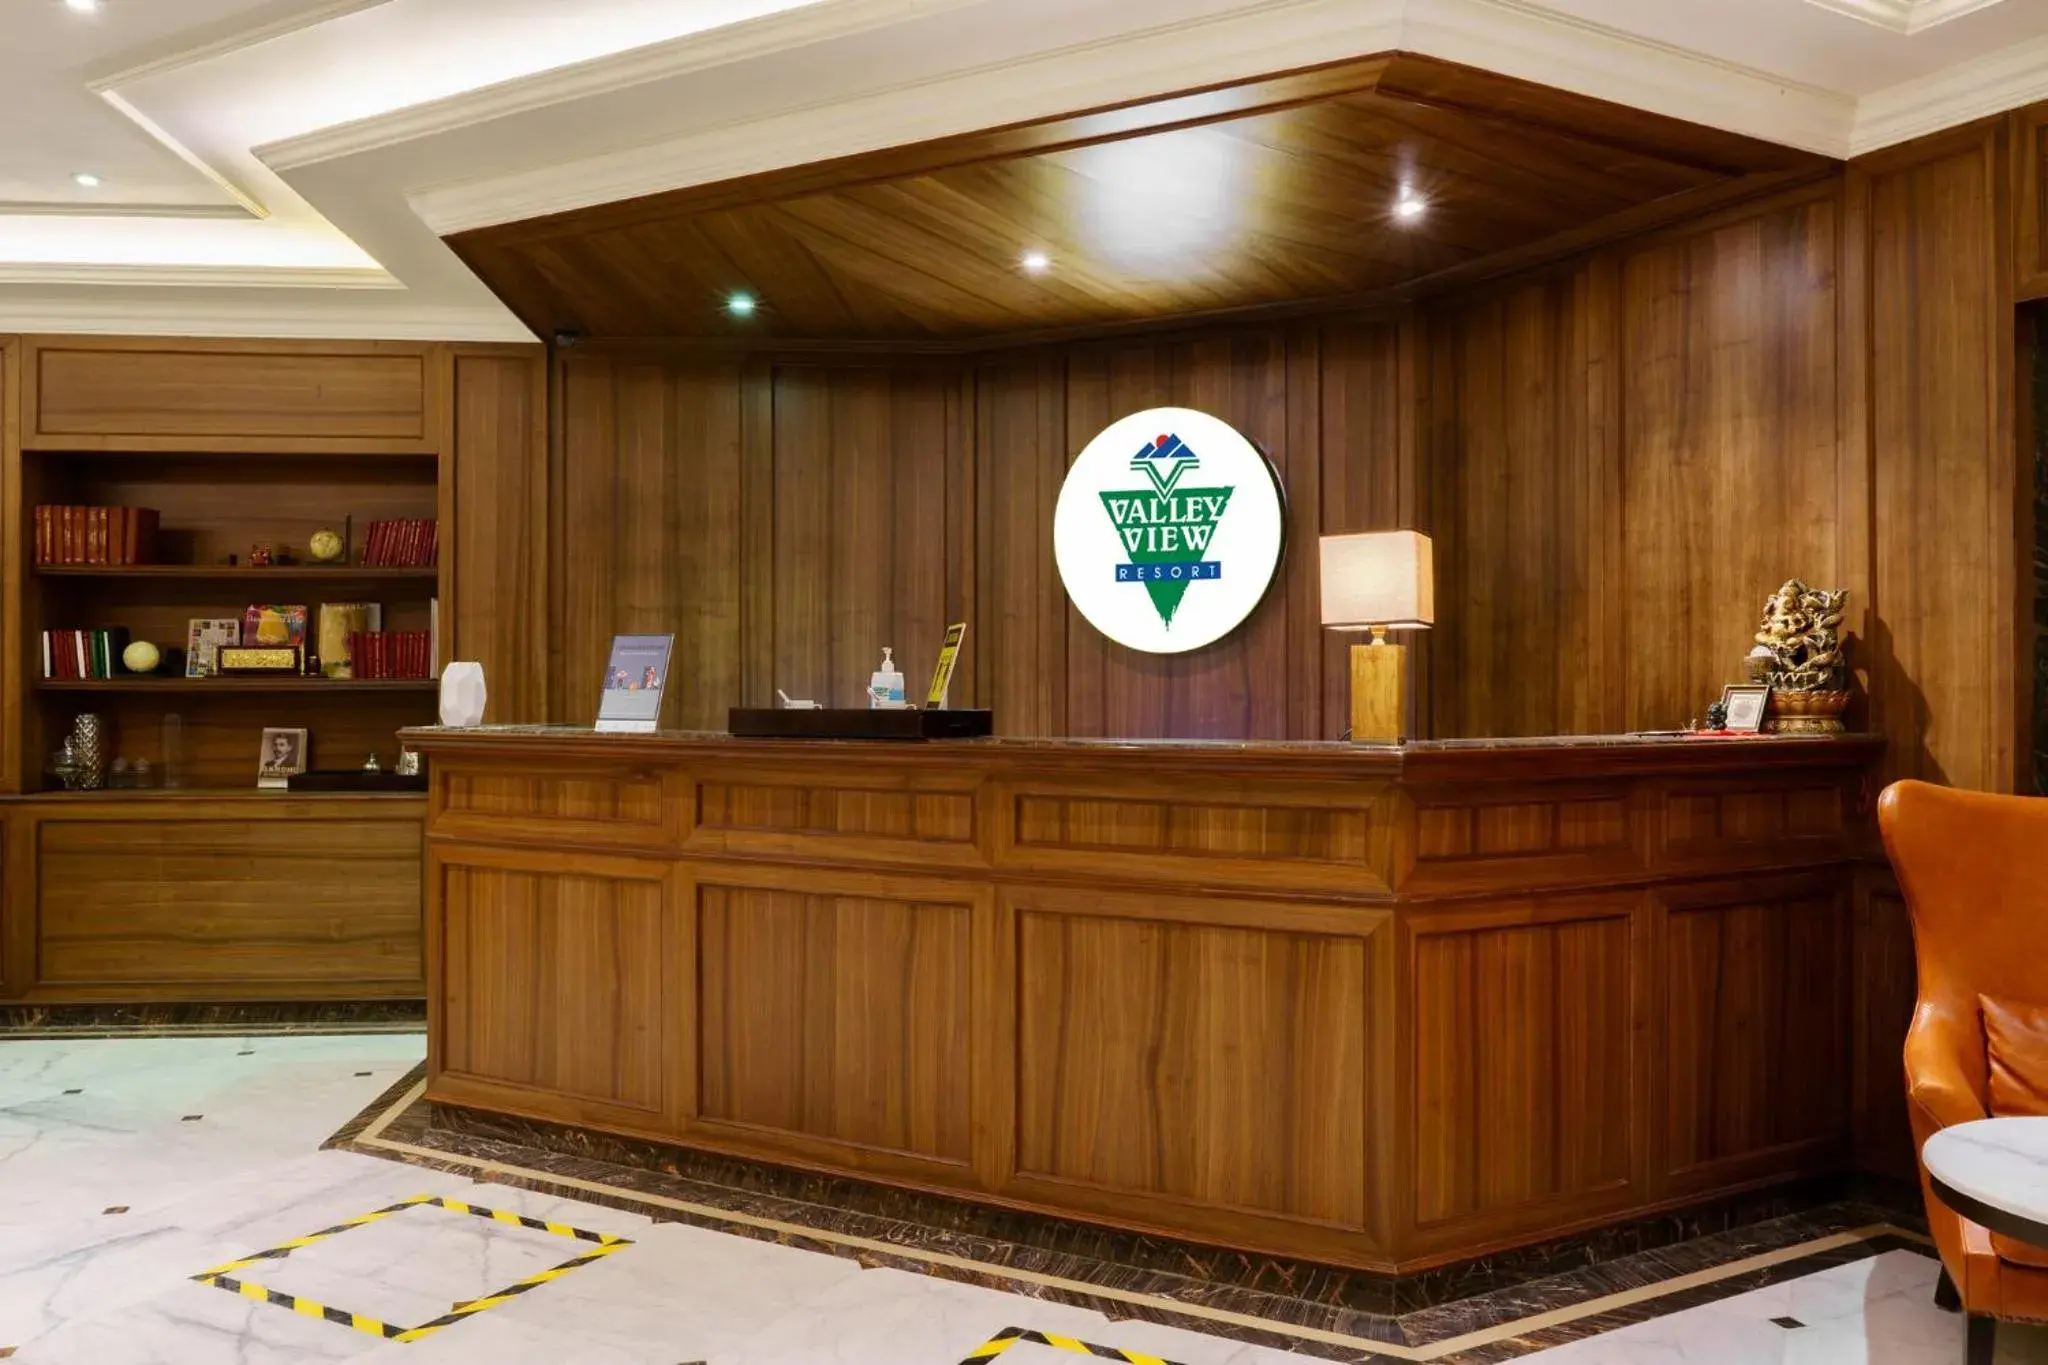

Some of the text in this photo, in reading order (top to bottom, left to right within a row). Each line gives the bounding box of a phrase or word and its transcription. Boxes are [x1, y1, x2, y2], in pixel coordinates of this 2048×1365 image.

[1108, 496, 1224, 524] VALLEY
[1122, 525, 1211, 553] VIEW
[1119, 565, 1217, 580] RESORT
